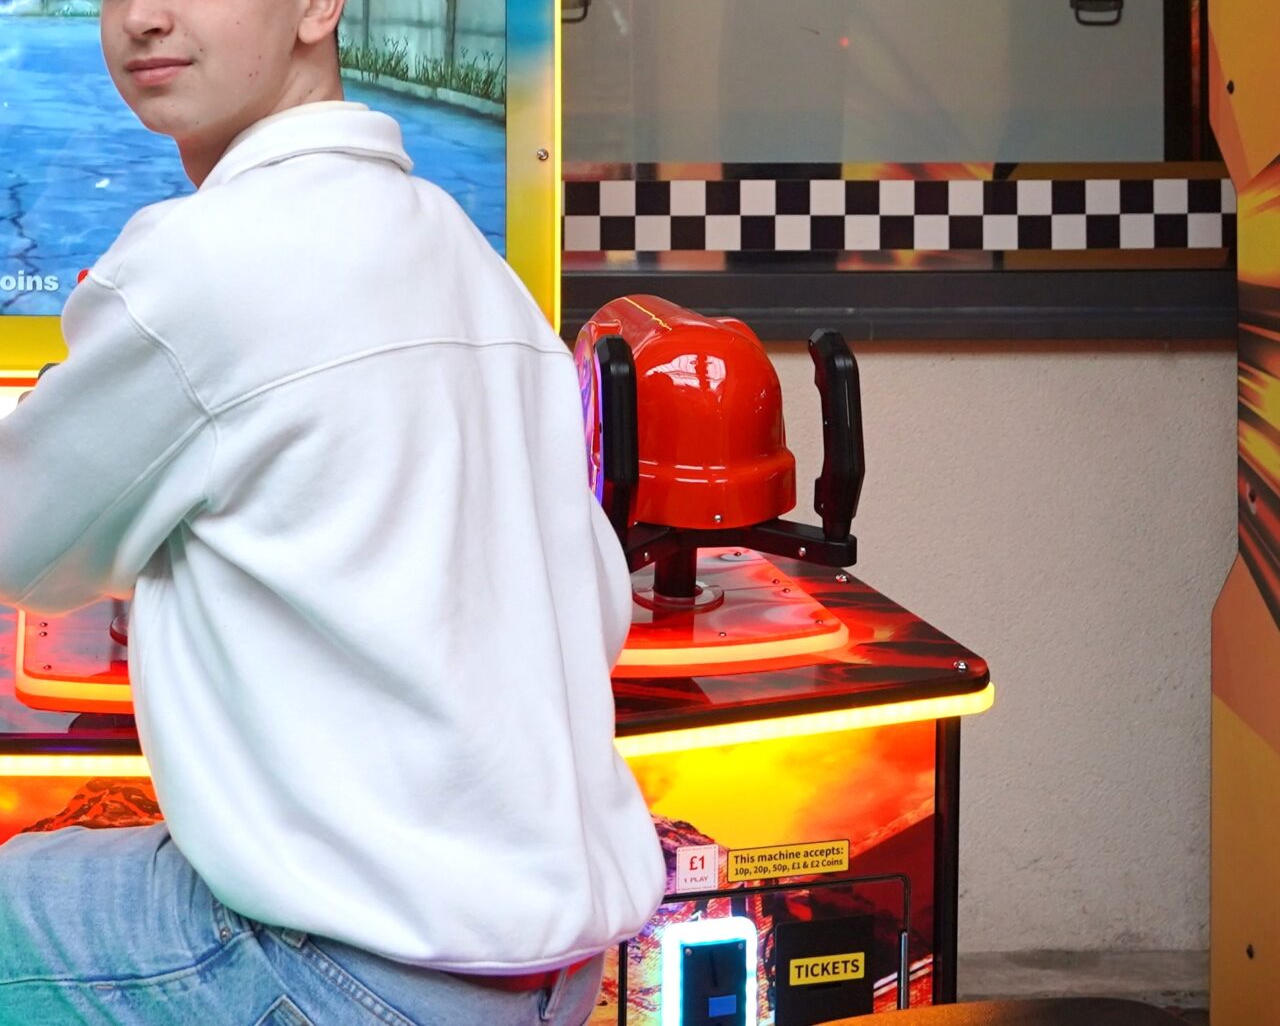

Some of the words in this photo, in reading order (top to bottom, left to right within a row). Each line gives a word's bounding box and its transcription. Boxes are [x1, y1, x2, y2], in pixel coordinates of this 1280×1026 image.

[734, 854, 755, 864] This
[757, 849, 801, 862] machine
[803, 846, 844, 859] accepts:
[689, 856, 705, 871] £1
[791, 862, 801, 870] £1
[802, 860, 809, 868] &
[810, 859, 820, 869] £2
[821, 858, 843, 867] Coins
[690, 876, 708, 884] PLAY
[795, 958, 860, 980] TICKETS
